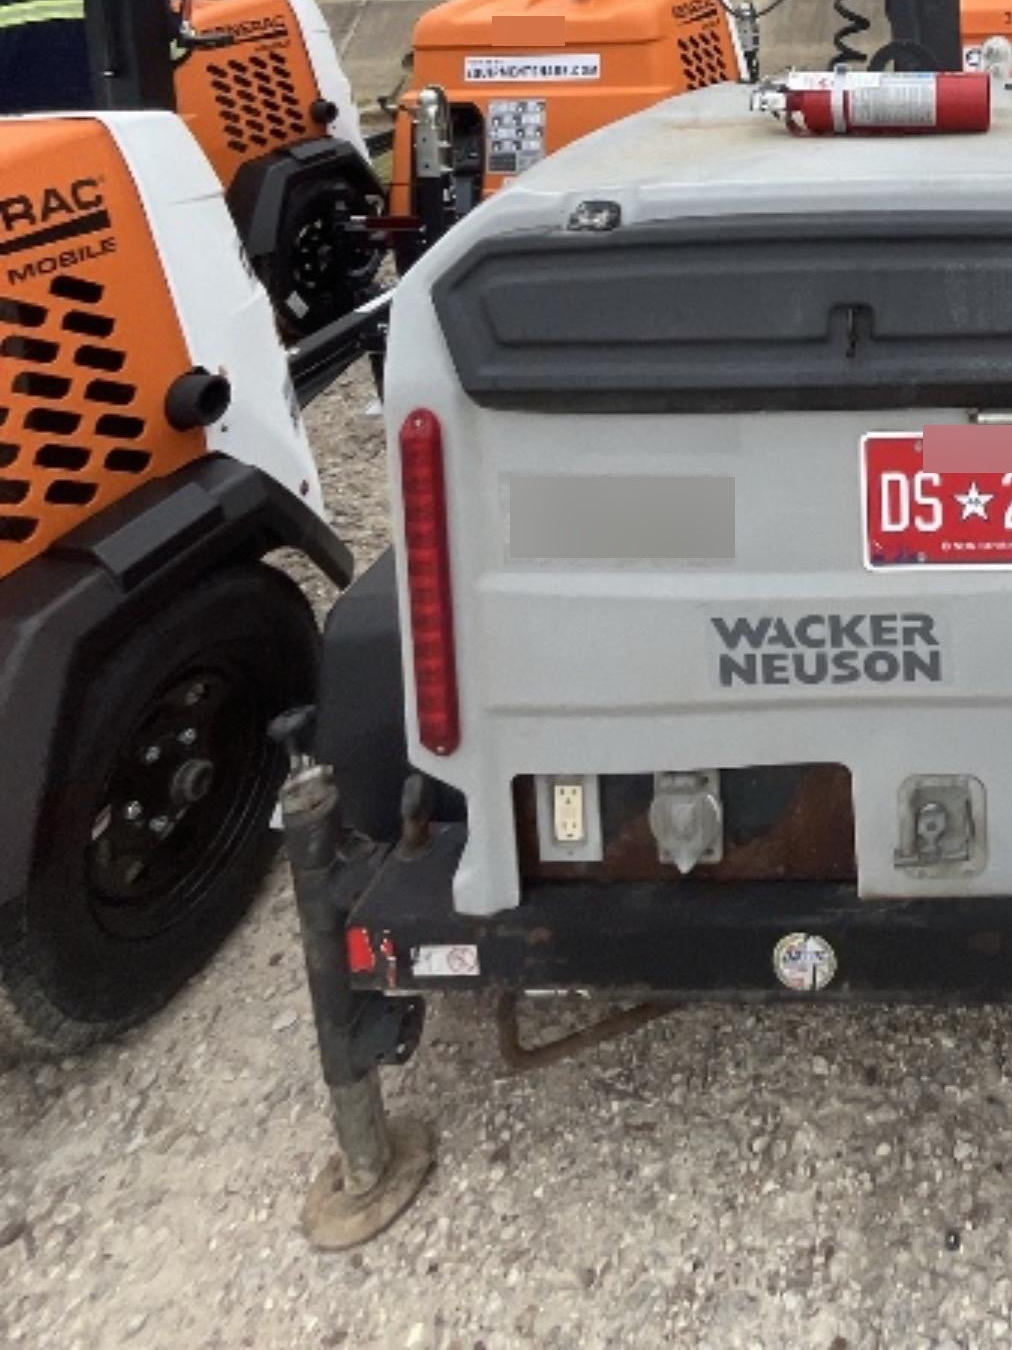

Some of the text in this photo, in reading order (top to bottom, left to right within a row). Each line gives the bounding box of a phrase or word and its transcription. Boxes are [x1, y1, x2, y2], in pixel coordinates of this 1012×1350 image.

[7, 237, 116, 286] MOBILE
[710, 612, 940, 650] WACKER
[719, 650, 942, 687] NEUSON
